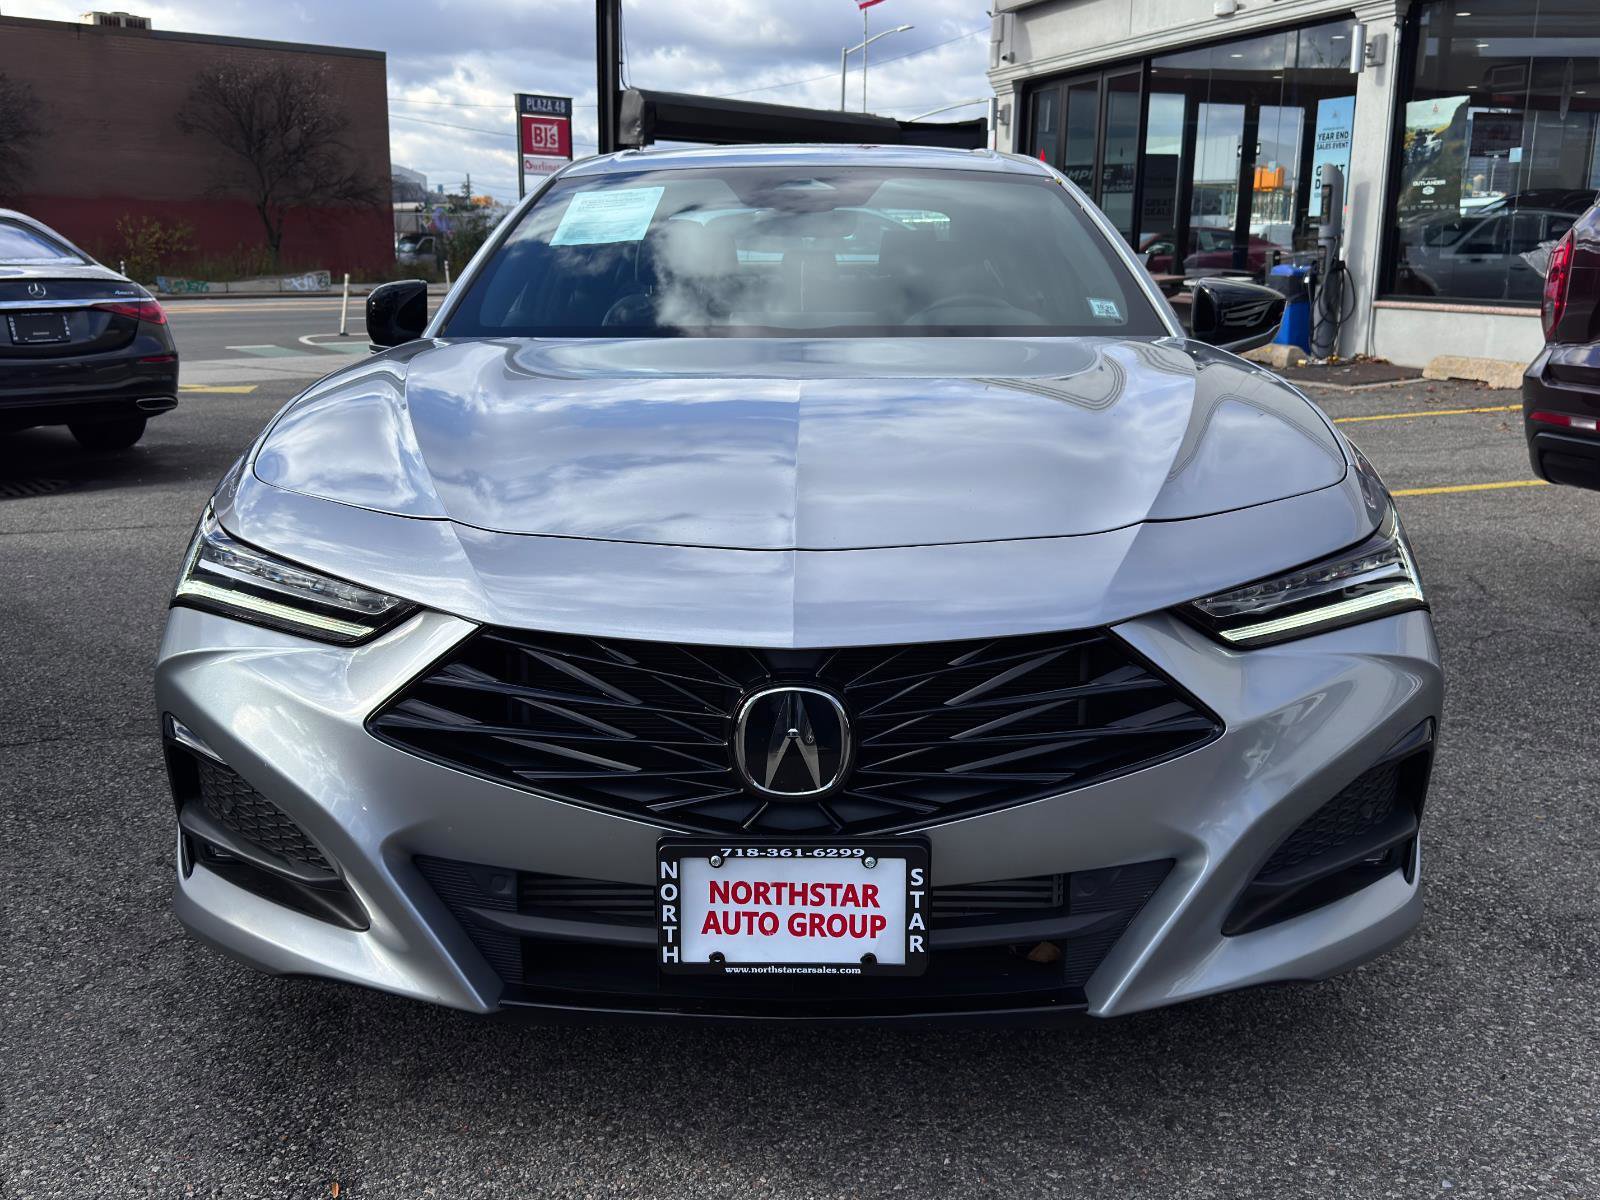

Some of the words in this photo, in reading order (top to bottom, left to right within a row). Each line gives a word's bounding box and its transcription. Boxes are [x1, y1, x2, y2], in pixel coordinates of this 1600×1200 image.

[526, 97, 552, 112] PLAZA
[554, 99, 566, 113] 48
[1317, 132, 1334, 141] YEAR
[1336, 131, 1349, 140] END
[1412, 179, 1446, 187] OUTLANDER
[720, 848, 865, 858] 718-361-6299
[708, 880, 880, 908] NORTHSTAR
[660, 861, 679, 964] NORTH
[909, 868, 925, 953] STAR
[701, 911, 780, 936] AUTO
[787, 913, 887, 939] GROUP
[725, 965, 861, 975] www.northstarcarsales.com
